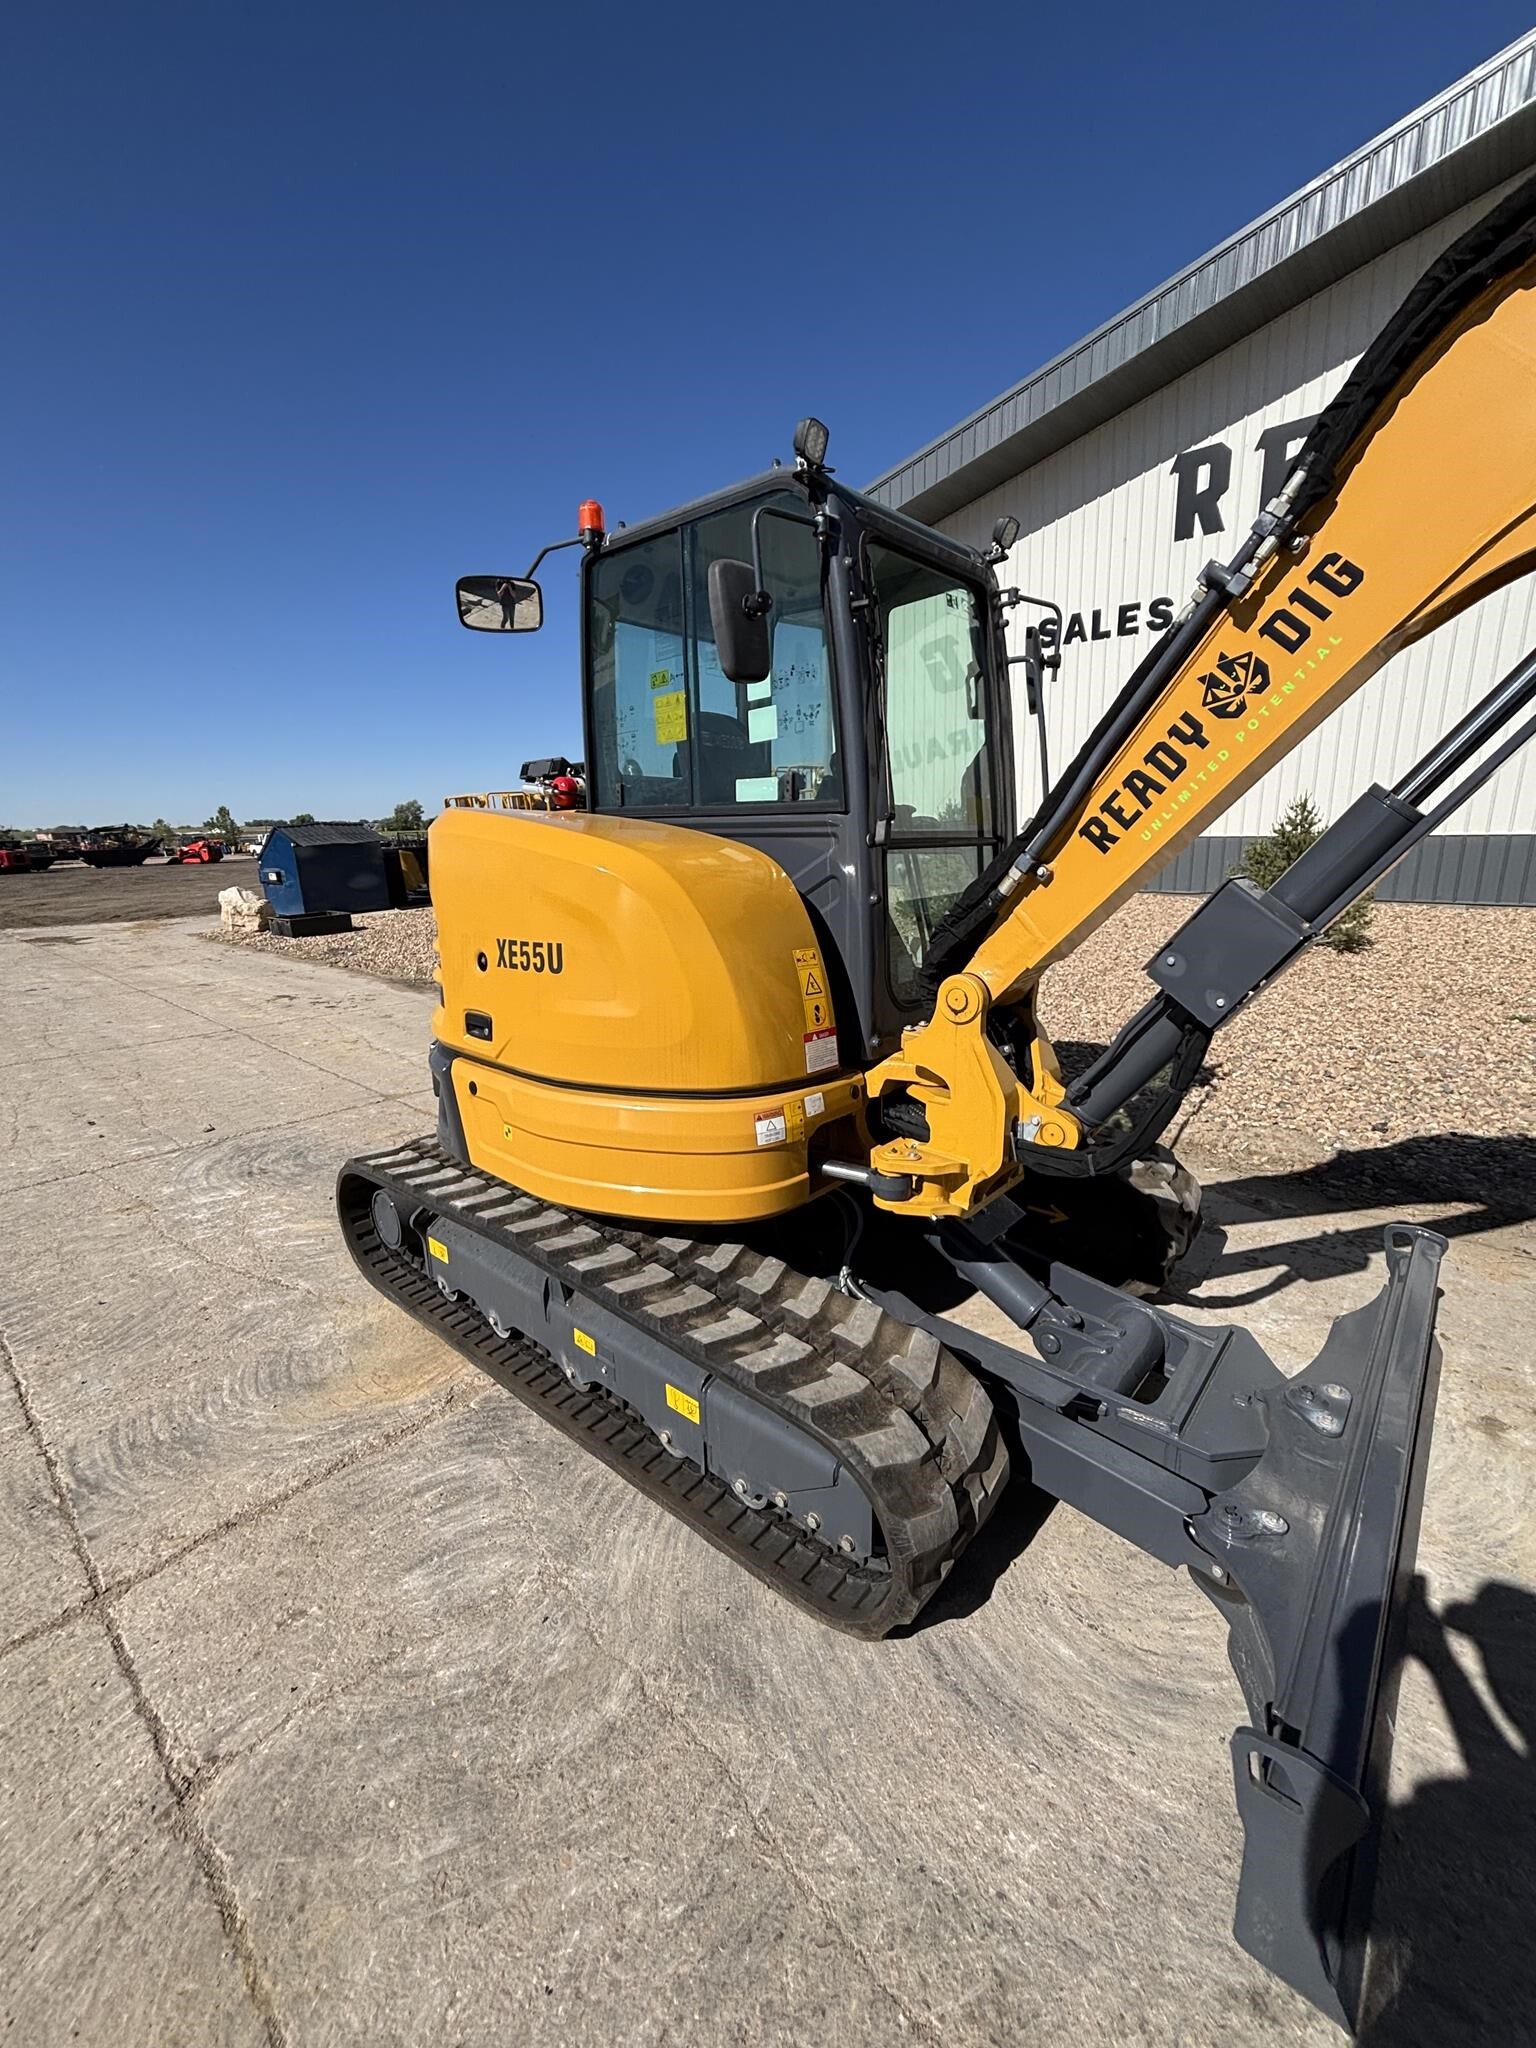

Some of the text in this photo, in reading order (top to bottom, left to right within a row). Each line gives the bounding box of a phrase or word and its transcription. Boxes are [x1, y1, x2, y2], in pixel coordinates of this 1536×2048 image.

[1038, 596, 1174, 649] SALES
[1078, 552, 1365, 854] READY DIG
[1140, 634, 1343, 842] UNLIMITED POTENTIAL
[496, 938, 564, 975] XE55U
